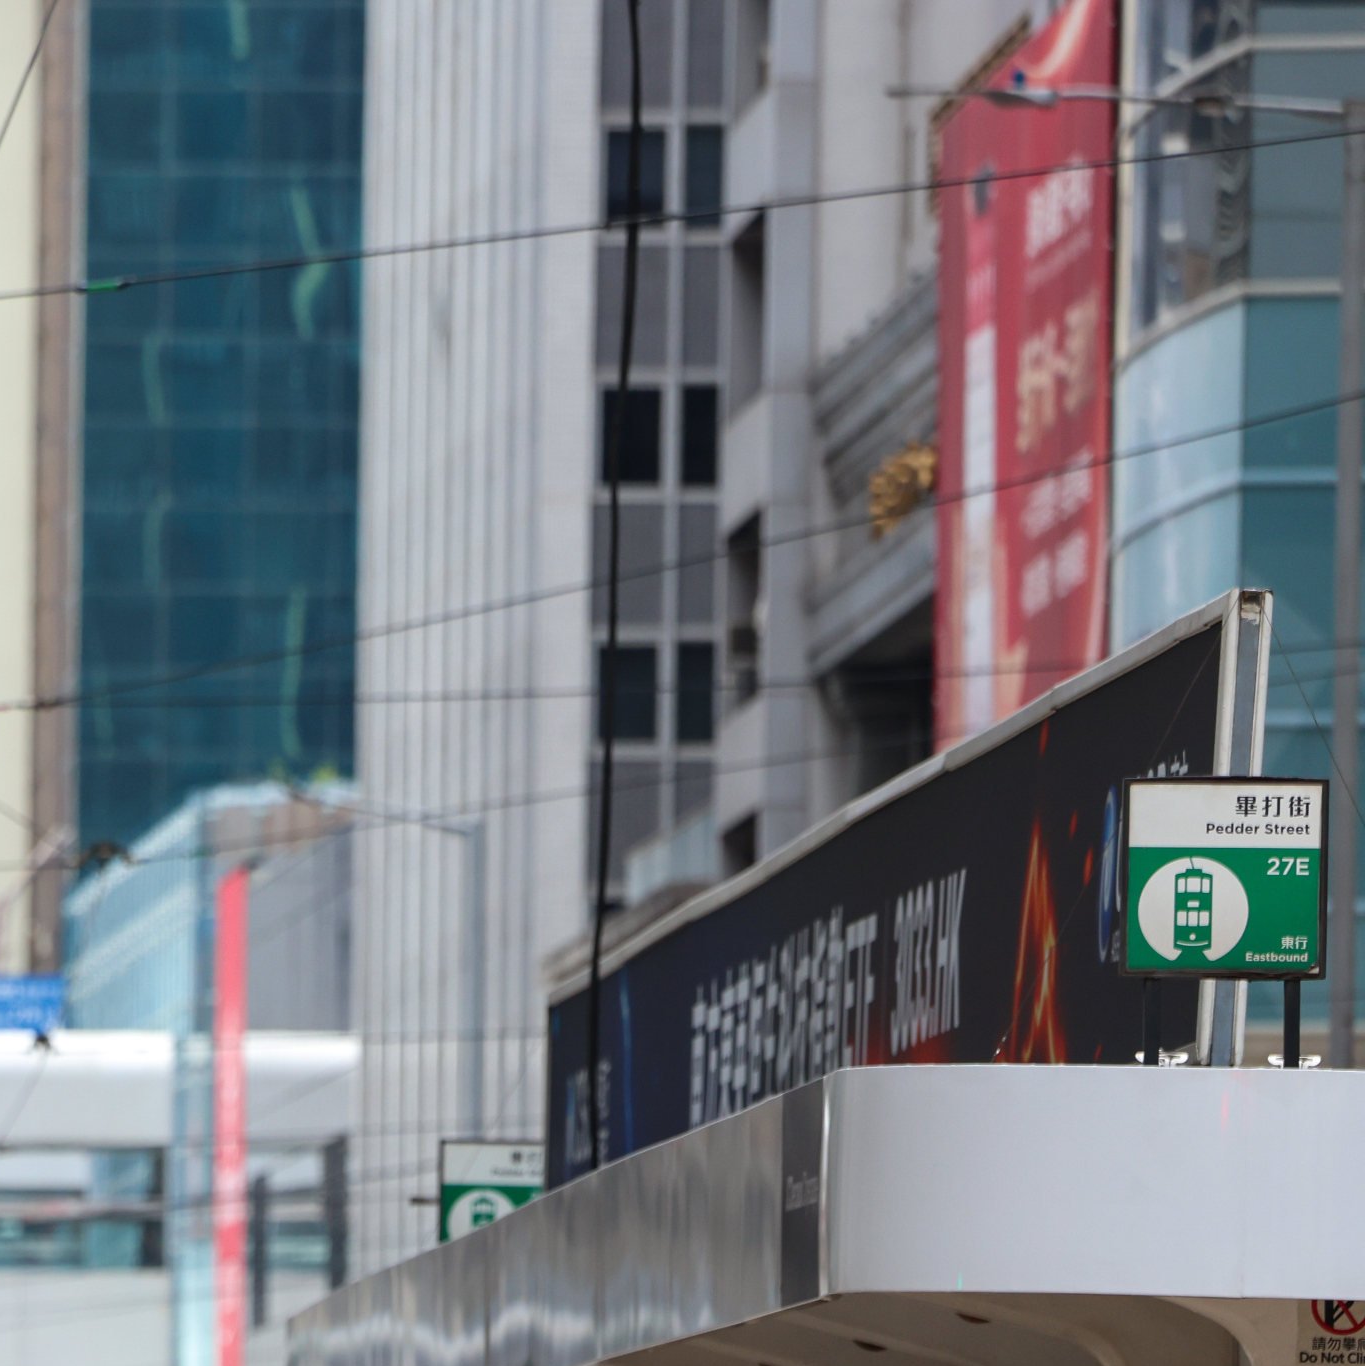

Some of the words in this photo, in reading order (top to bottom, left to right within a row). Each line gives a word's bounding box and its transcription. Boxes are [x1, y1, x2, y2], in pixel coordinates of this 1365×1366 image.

[1235, 796, 1310, 818] 畢打街
[1206, 823, 1259, 835] Pedder
[1265, 823, 1310, 835] Street
[1267, 857, 1310, 876] 27E
[1281, 936, 1308, 950] 東行
[1245, 952, 1308, 963] Eastbound
[1299, 1352, 1317, 1363] Do
[1321, 1352, 1345, 1364] Not
[1348, 1352, 1365, 1365] Cli
